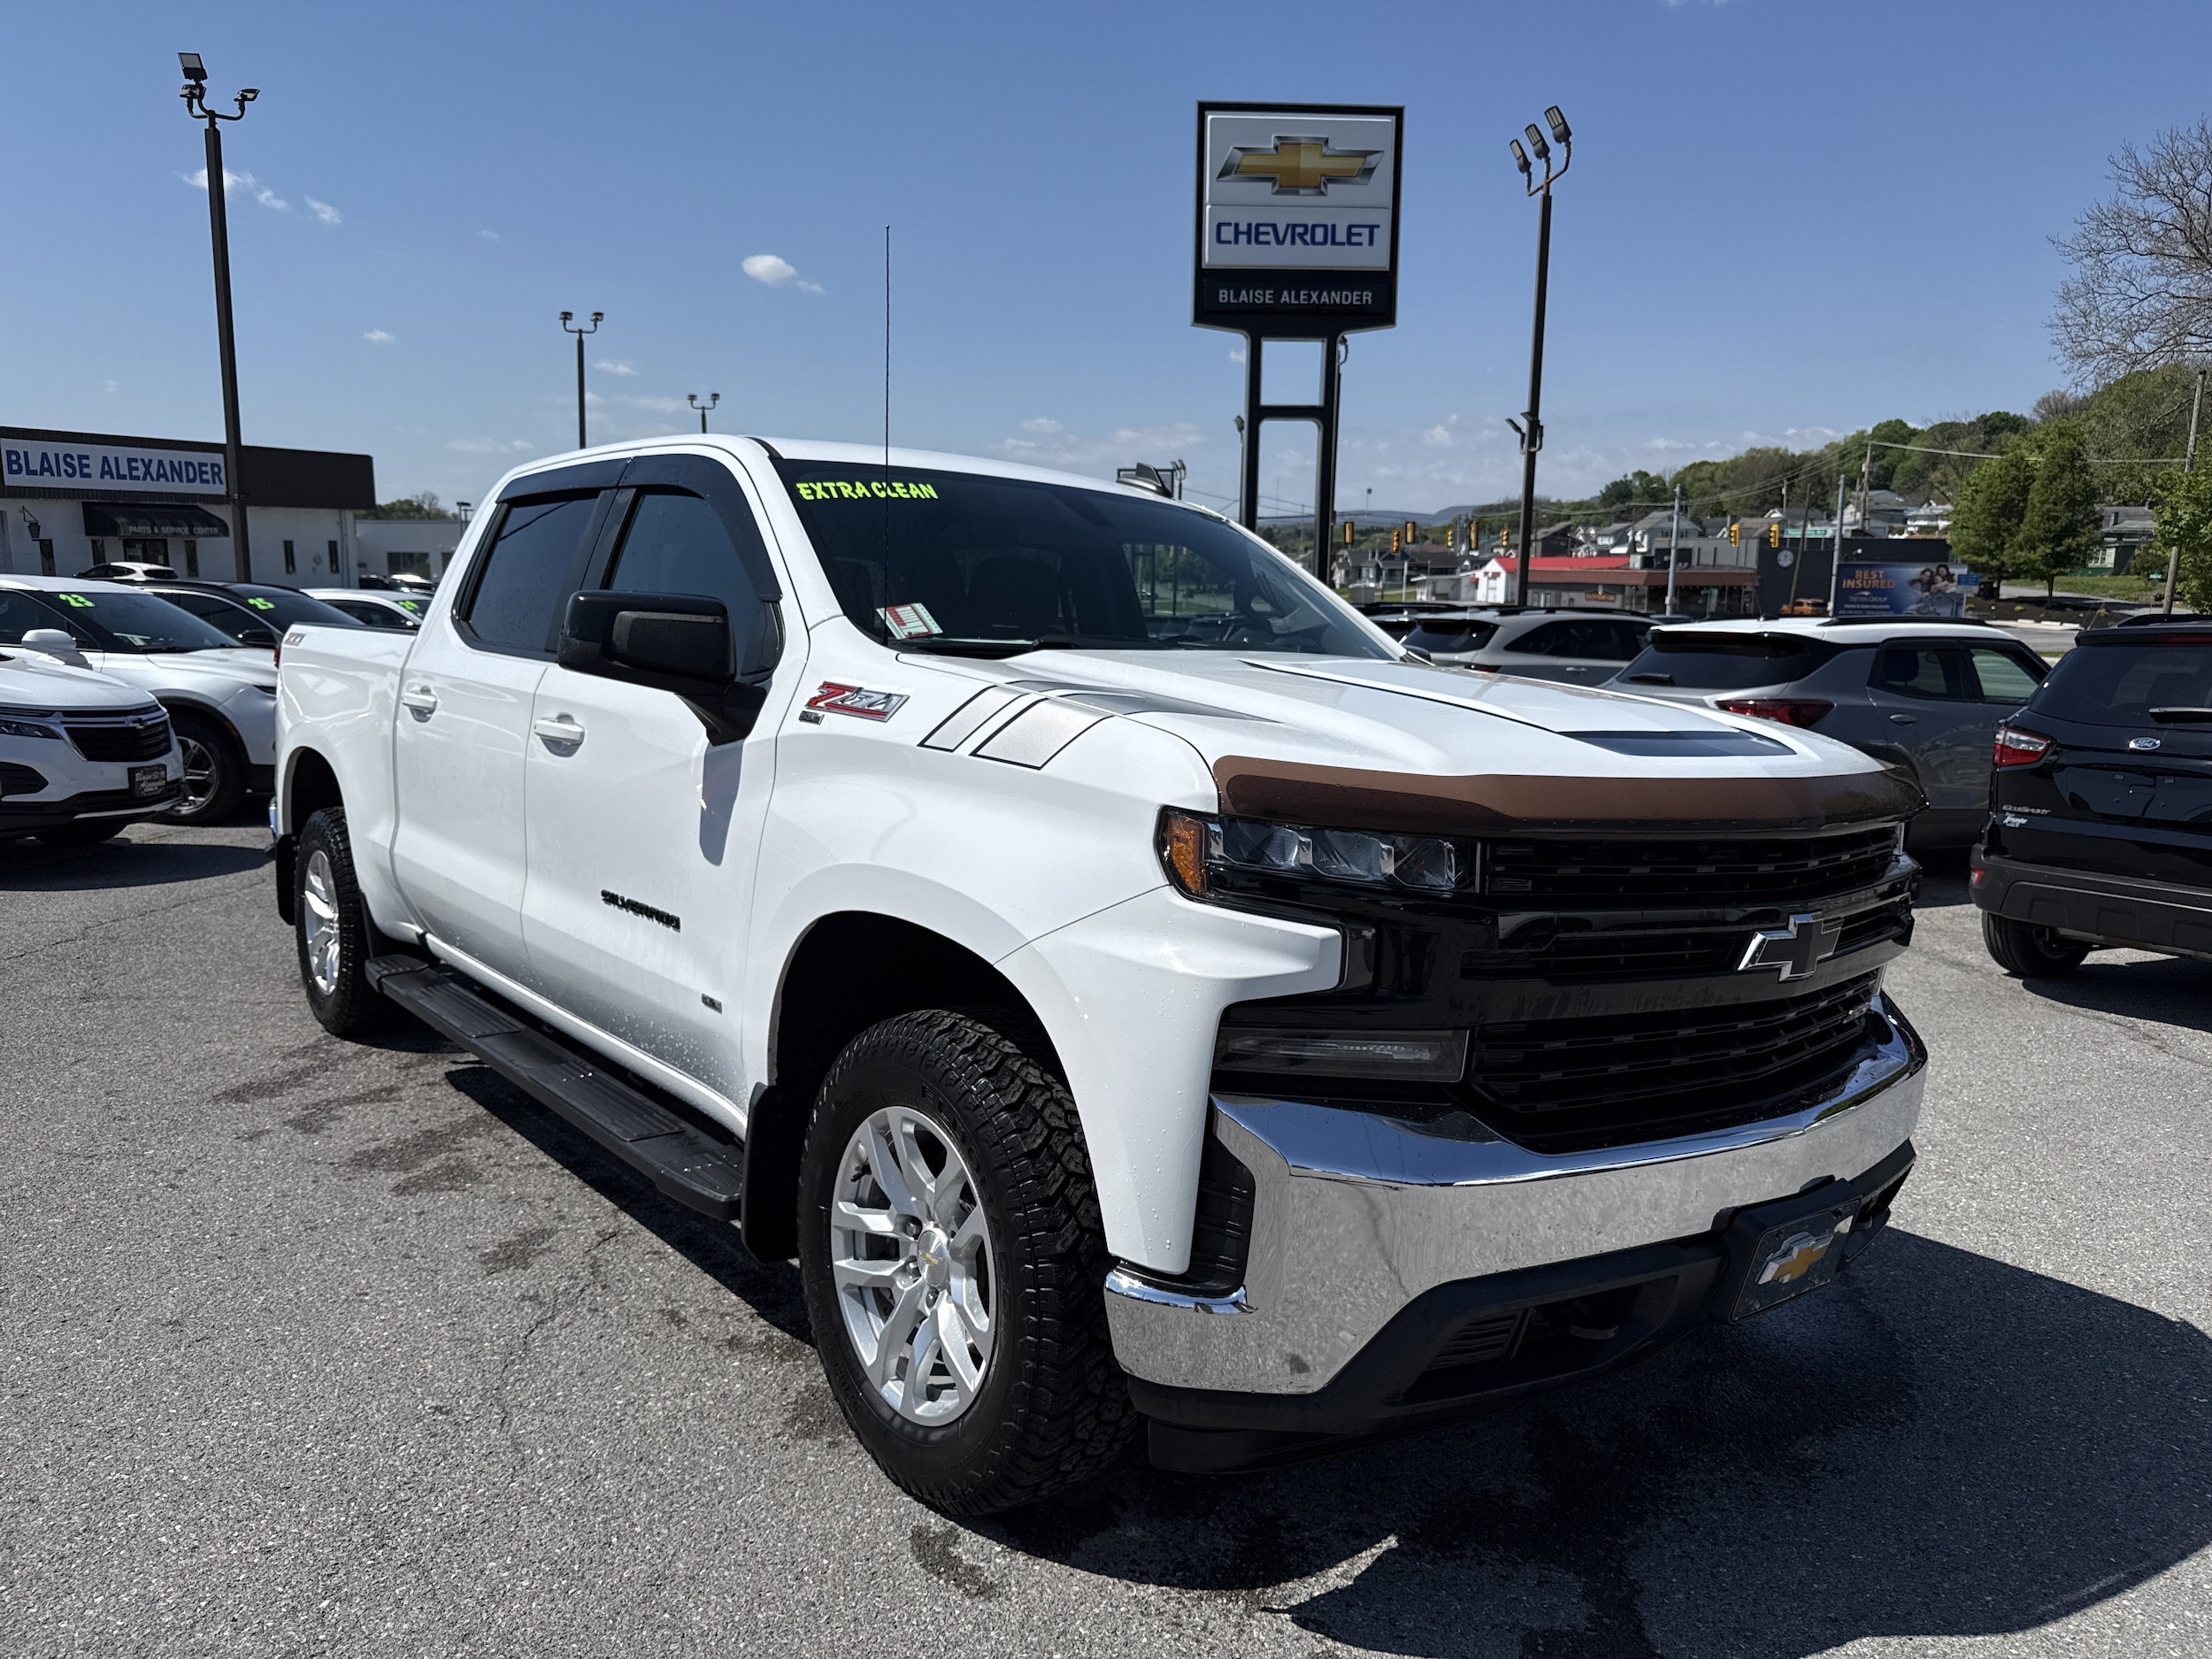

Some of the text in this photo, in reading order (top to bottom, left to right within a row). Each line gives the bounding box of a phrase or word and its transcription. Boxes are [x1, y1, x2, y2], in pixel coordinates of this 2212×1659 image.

[1216, 221, 1380, 247] CHEVROLET
[1218, 288, 1372, 305] BLAISE ALEXANDER
[5, 449, 225, 486] BLAISE ALEXANDER
[796, 480, 939, 501] EXTRA CLEAN
[128, 525, 219, 535] PARTS & SERVICE CENTER
[1854, 569, 1886, 580] REST
[1841, 579, 1896, 590] INSURED
[58, 594, 96, 608] 23
[805, 680, 910, 723] Z71
